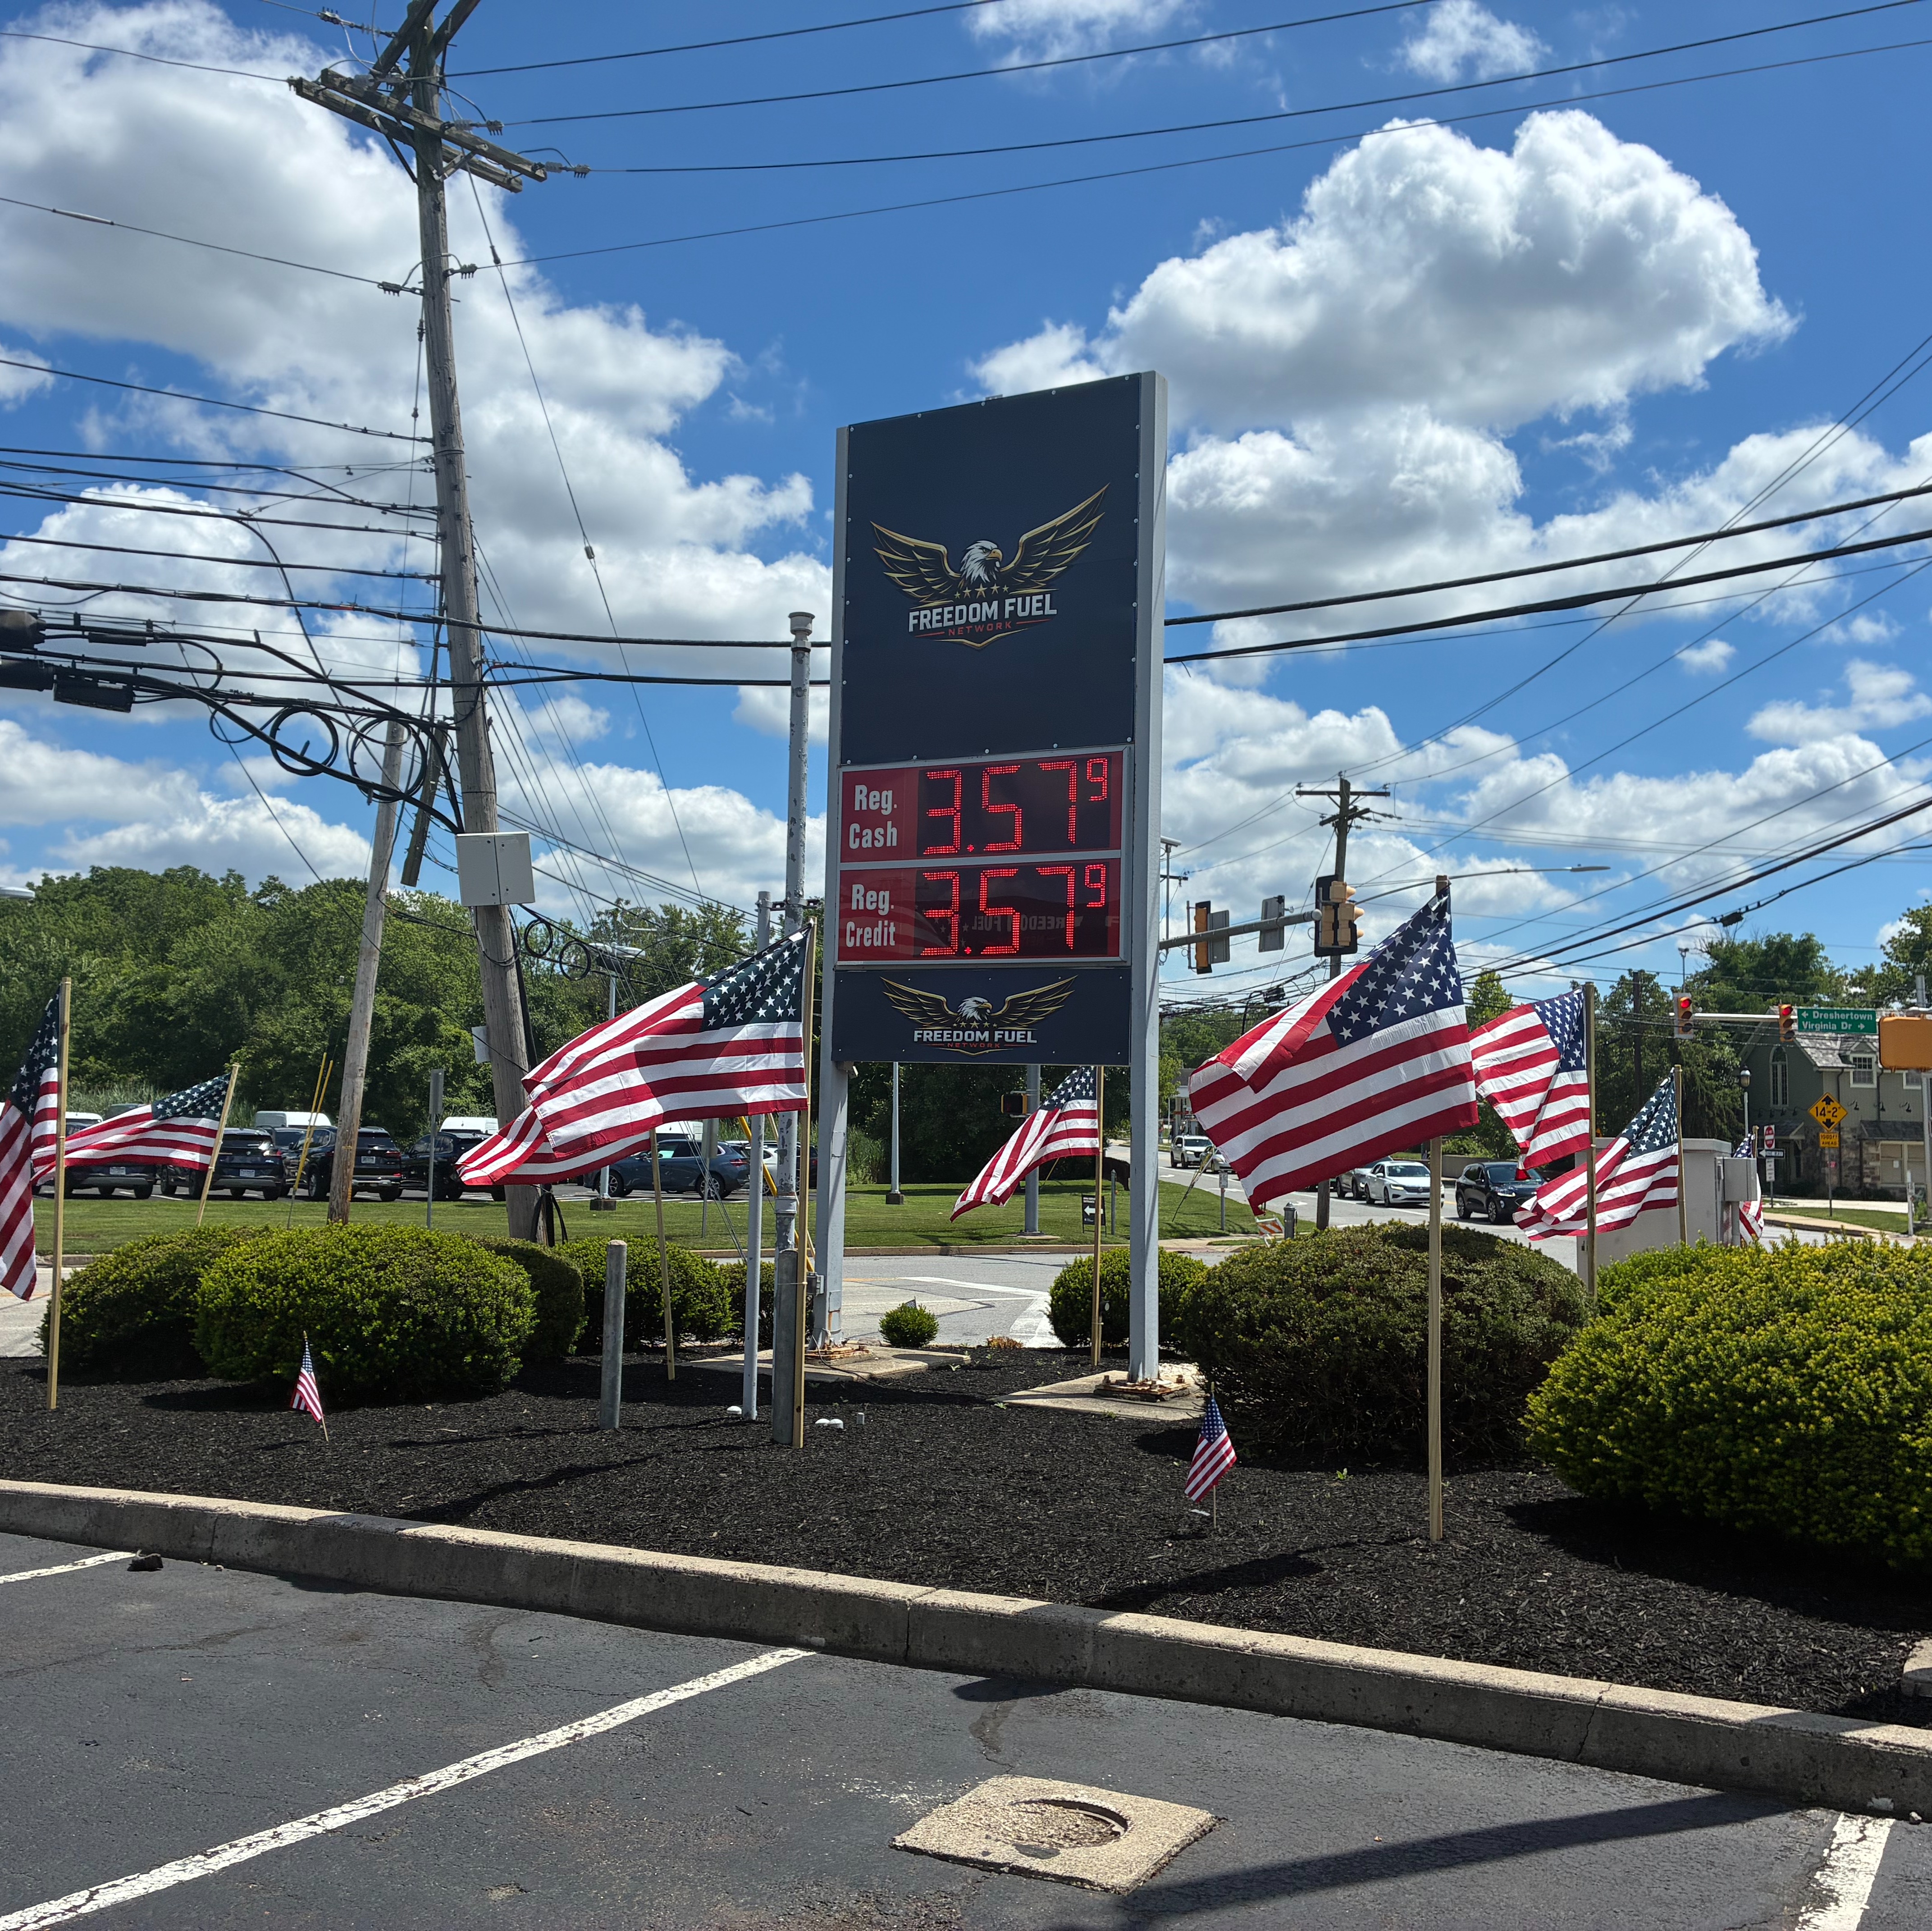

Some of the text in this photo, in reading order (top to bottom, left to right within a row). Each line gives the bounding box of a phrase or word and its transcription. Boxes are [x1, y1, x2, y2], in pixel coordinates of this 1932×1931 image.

[909, 594, 1057, 632] FREEDOM FUEL
[948, 621, 1012, 636] NETWORK
[854, 785, 897, 815] Reg.
[849, 821, 898, 849] Cash
[851, 884, 895, 915] Reg.
[846, 921, 896, 948] Credit
[1802, 1021, 1852, 1031] Virginia Dr
[1813, 1011, 1873, 1020] Dreshertown
[913, 1030, 1037, 1043] FREEDOM FUEL
